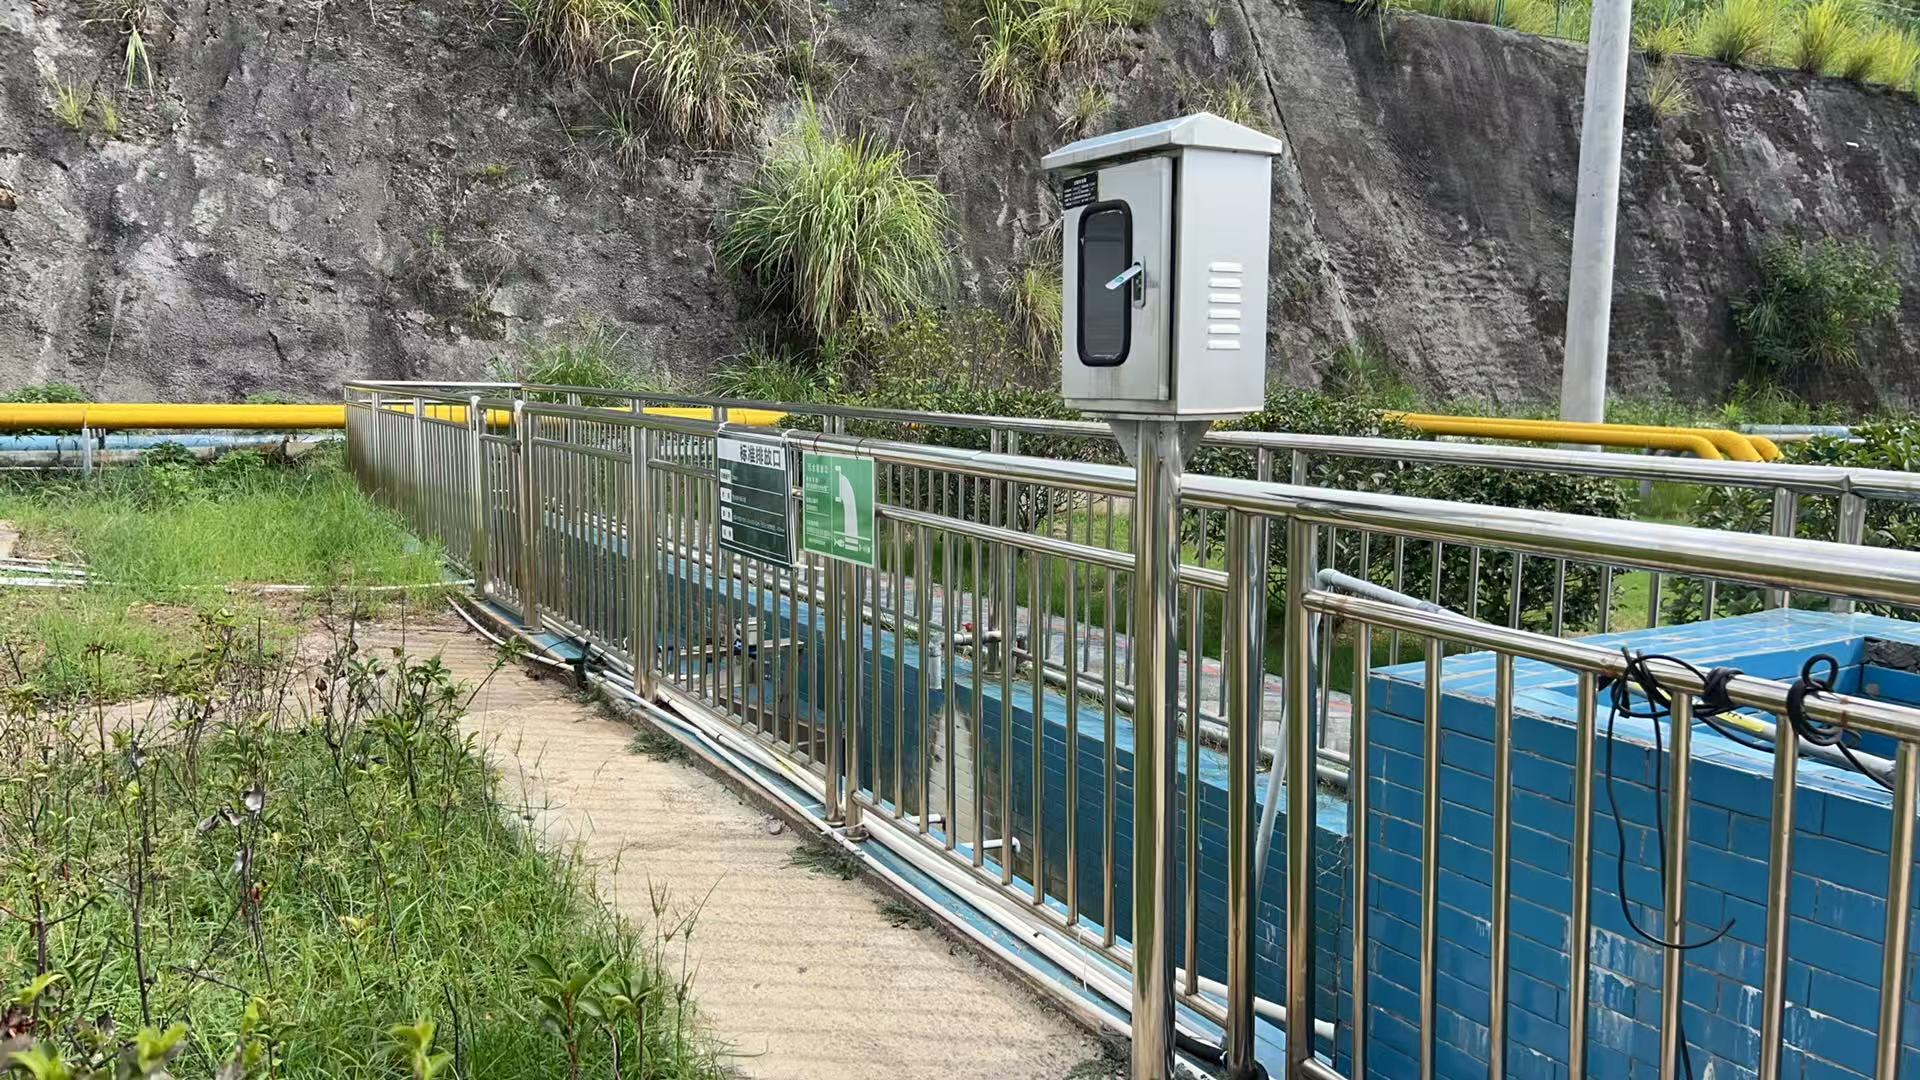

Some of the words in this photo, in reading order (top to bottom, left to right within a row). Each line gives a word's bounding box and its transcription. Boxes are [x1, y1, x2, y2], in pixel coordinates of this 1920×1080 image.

[740, 444, 781, 468] 标准排放口
